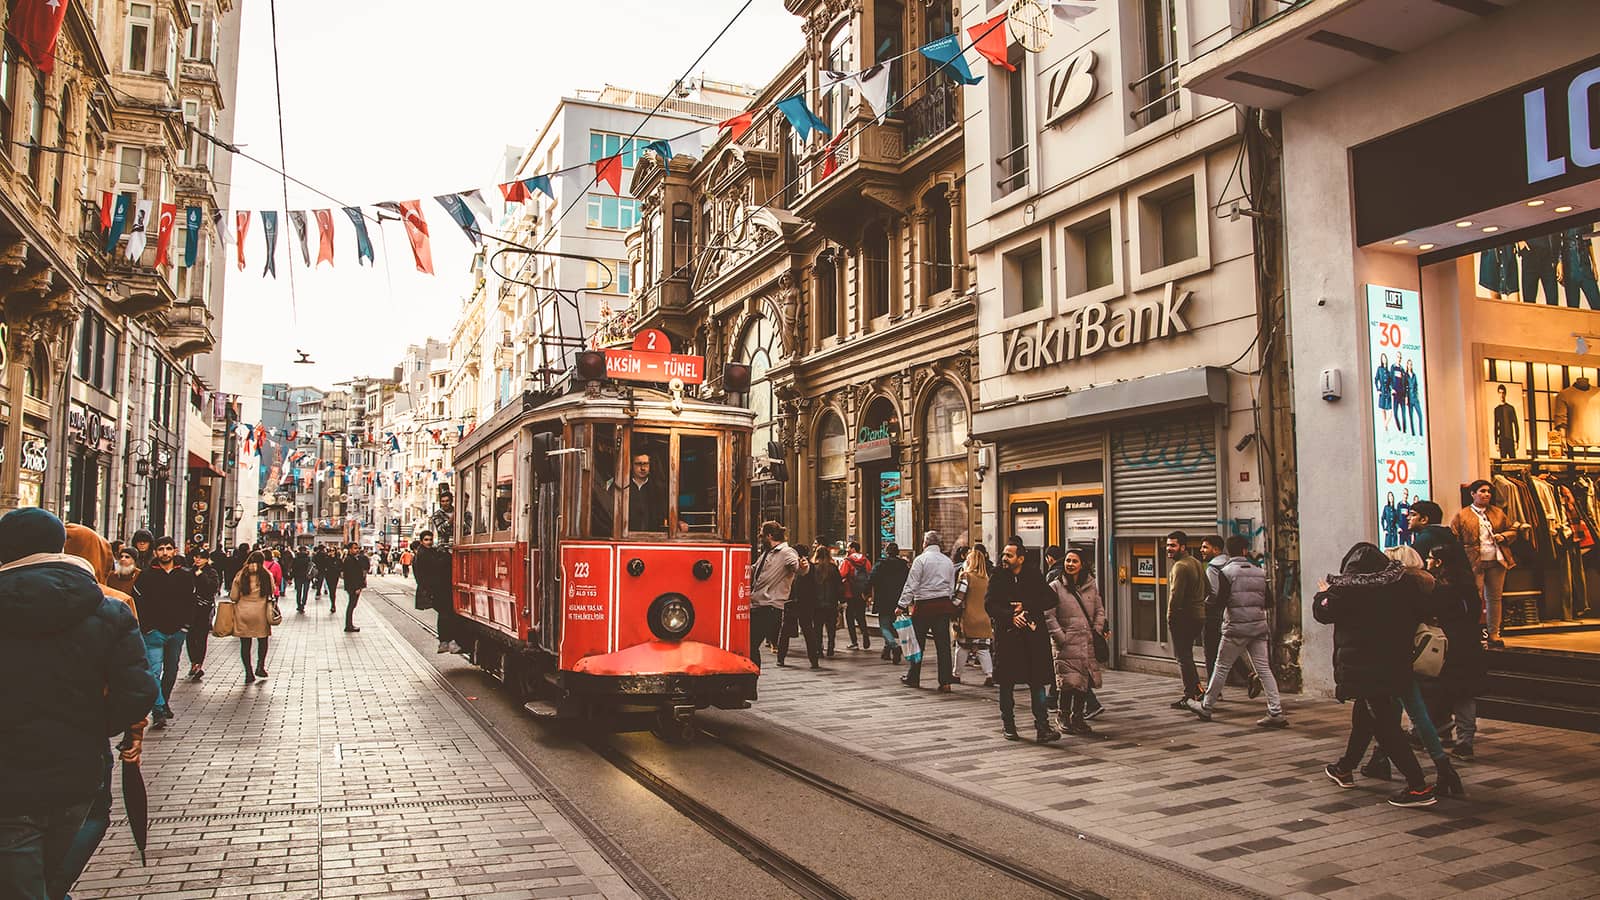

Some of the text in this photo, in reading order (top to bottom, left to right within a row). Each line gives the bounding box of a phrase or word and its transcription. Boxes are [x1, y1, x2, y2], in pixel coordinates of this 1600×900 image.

[1385, 291, 1402, 305] LOFT
[1002, 281, 1194, 374] VakıfBank
[1379, 322, 1401, 348] 30
[647, 332, 656, 350] 2
[605, 354, 641, 373] AKSİM
[664, 358, 698, 378] TÜNEL
[1386, 459, 1408, 484] 30
[574, 562, 589, 578] 223
[1139, 560, 1153, 571] Ria
